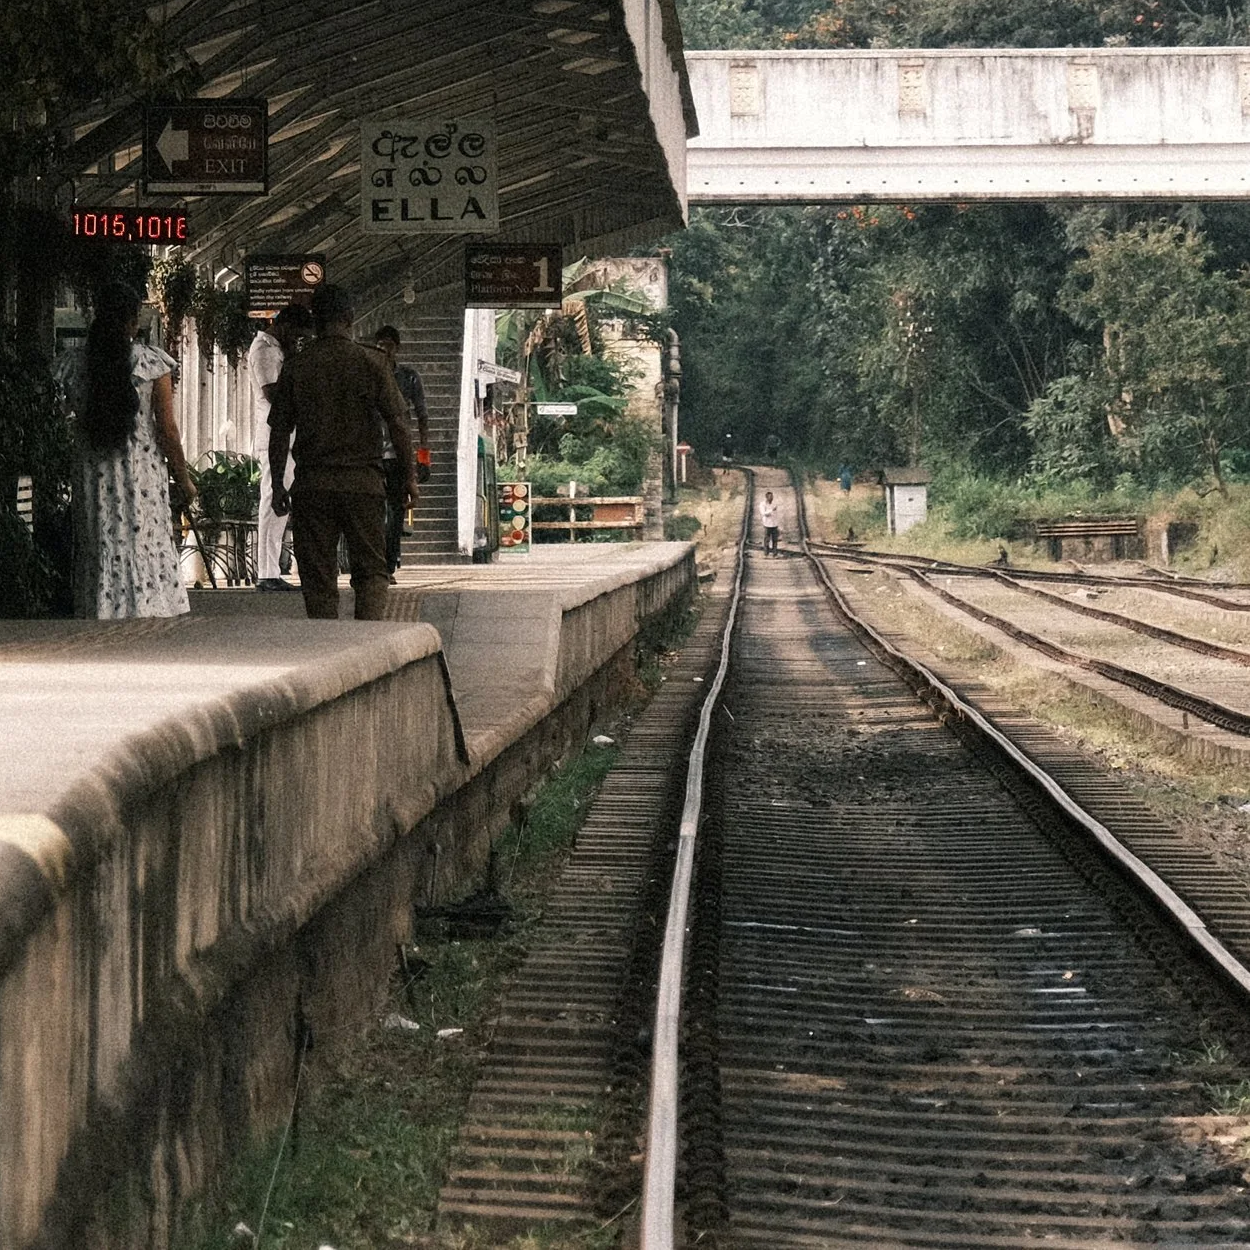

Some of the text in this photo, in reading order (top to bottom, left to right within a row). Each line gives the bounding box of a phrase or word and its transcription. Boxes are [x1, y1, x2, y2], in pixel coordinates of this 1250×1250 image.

[372, 123, 486, 162] ඇල්ල
[204, 158, 248, 174] EXIT
[372, 197, 486, 222] ELLA
[533, 257, 554, 292] 1
[471, 284, 512, 294] Platform
